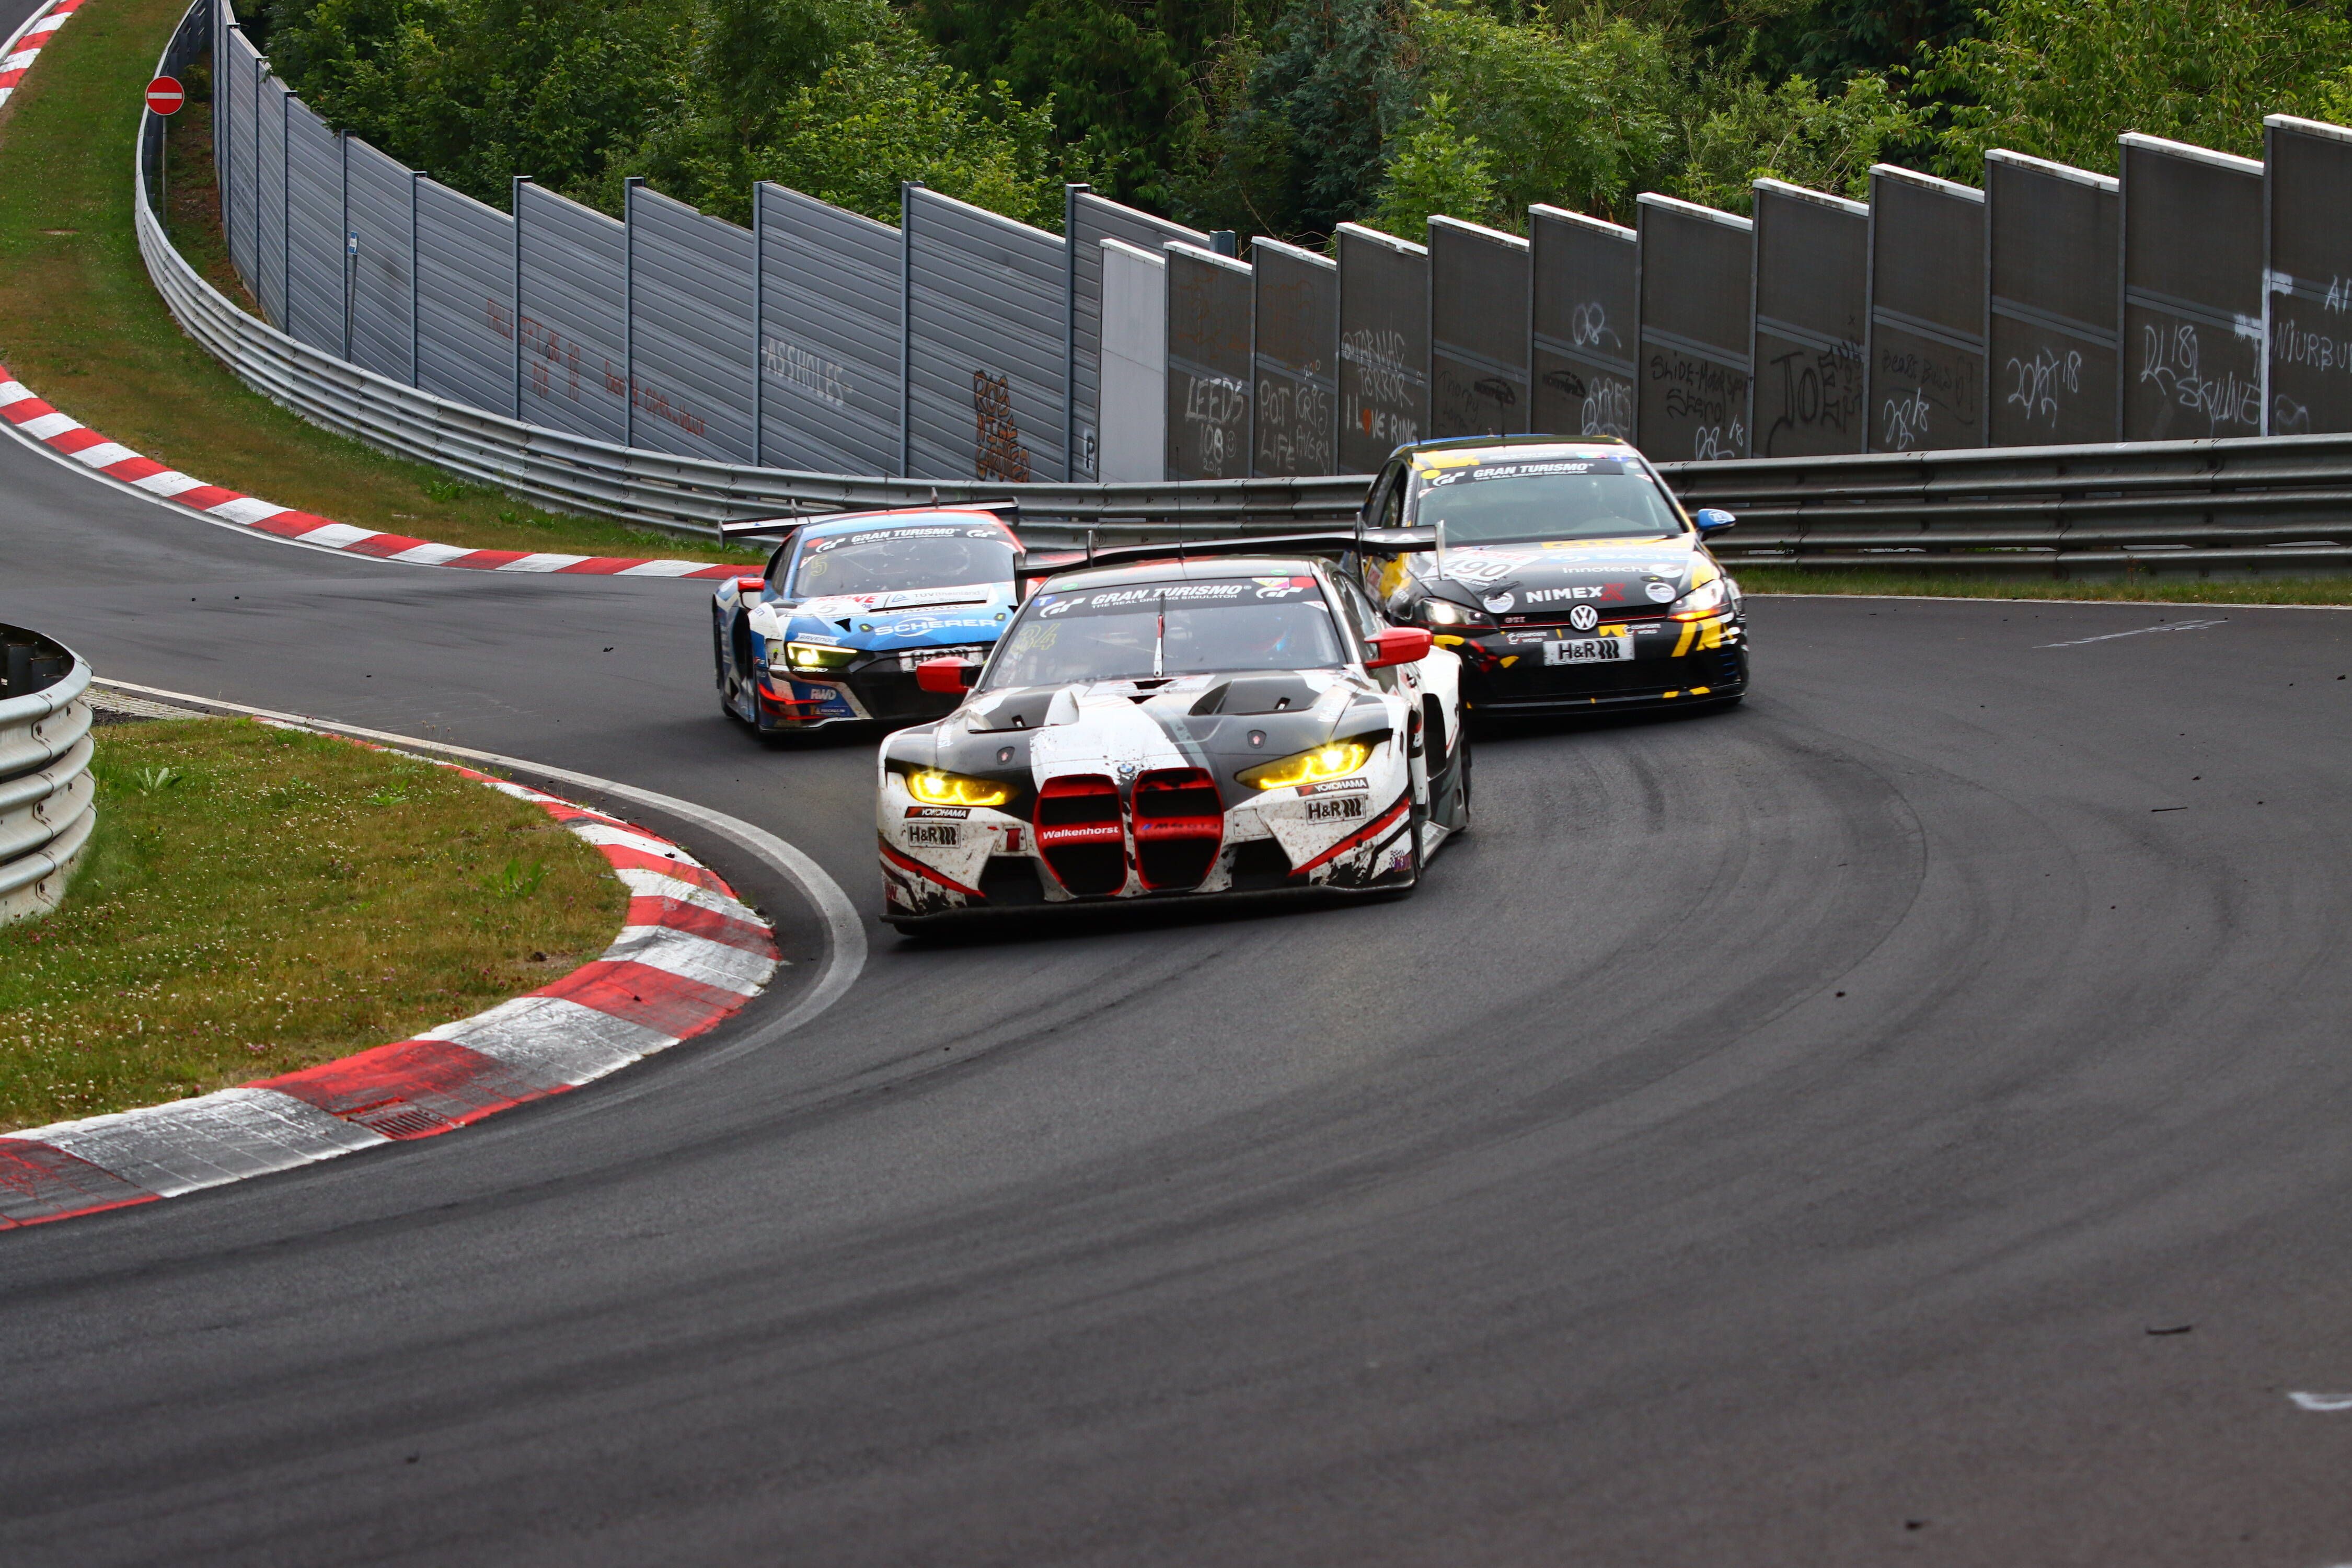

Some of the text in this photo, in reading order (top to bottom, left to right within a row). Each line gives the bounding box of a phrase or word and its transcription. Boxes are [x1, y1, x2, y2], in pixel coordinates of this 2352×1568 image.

[1473, 465, 1518, 478] GRAN
[851, 531, 891, 543] GRAN
[1562, 565, 1643, 574] Innotech
[1091, 588, 1150, 605] GRAN
[874, 619, 998, 636] SCHERER
[1559, 642, 1596, 660] H&R
[810, 688, 837, 701] RWD
[1314, 779, 1368, 793] YOKOHAMA
[921, 808, 967, 818] YOKOHAMA
[1042, 825, 1120, 840] Walkenhorst
